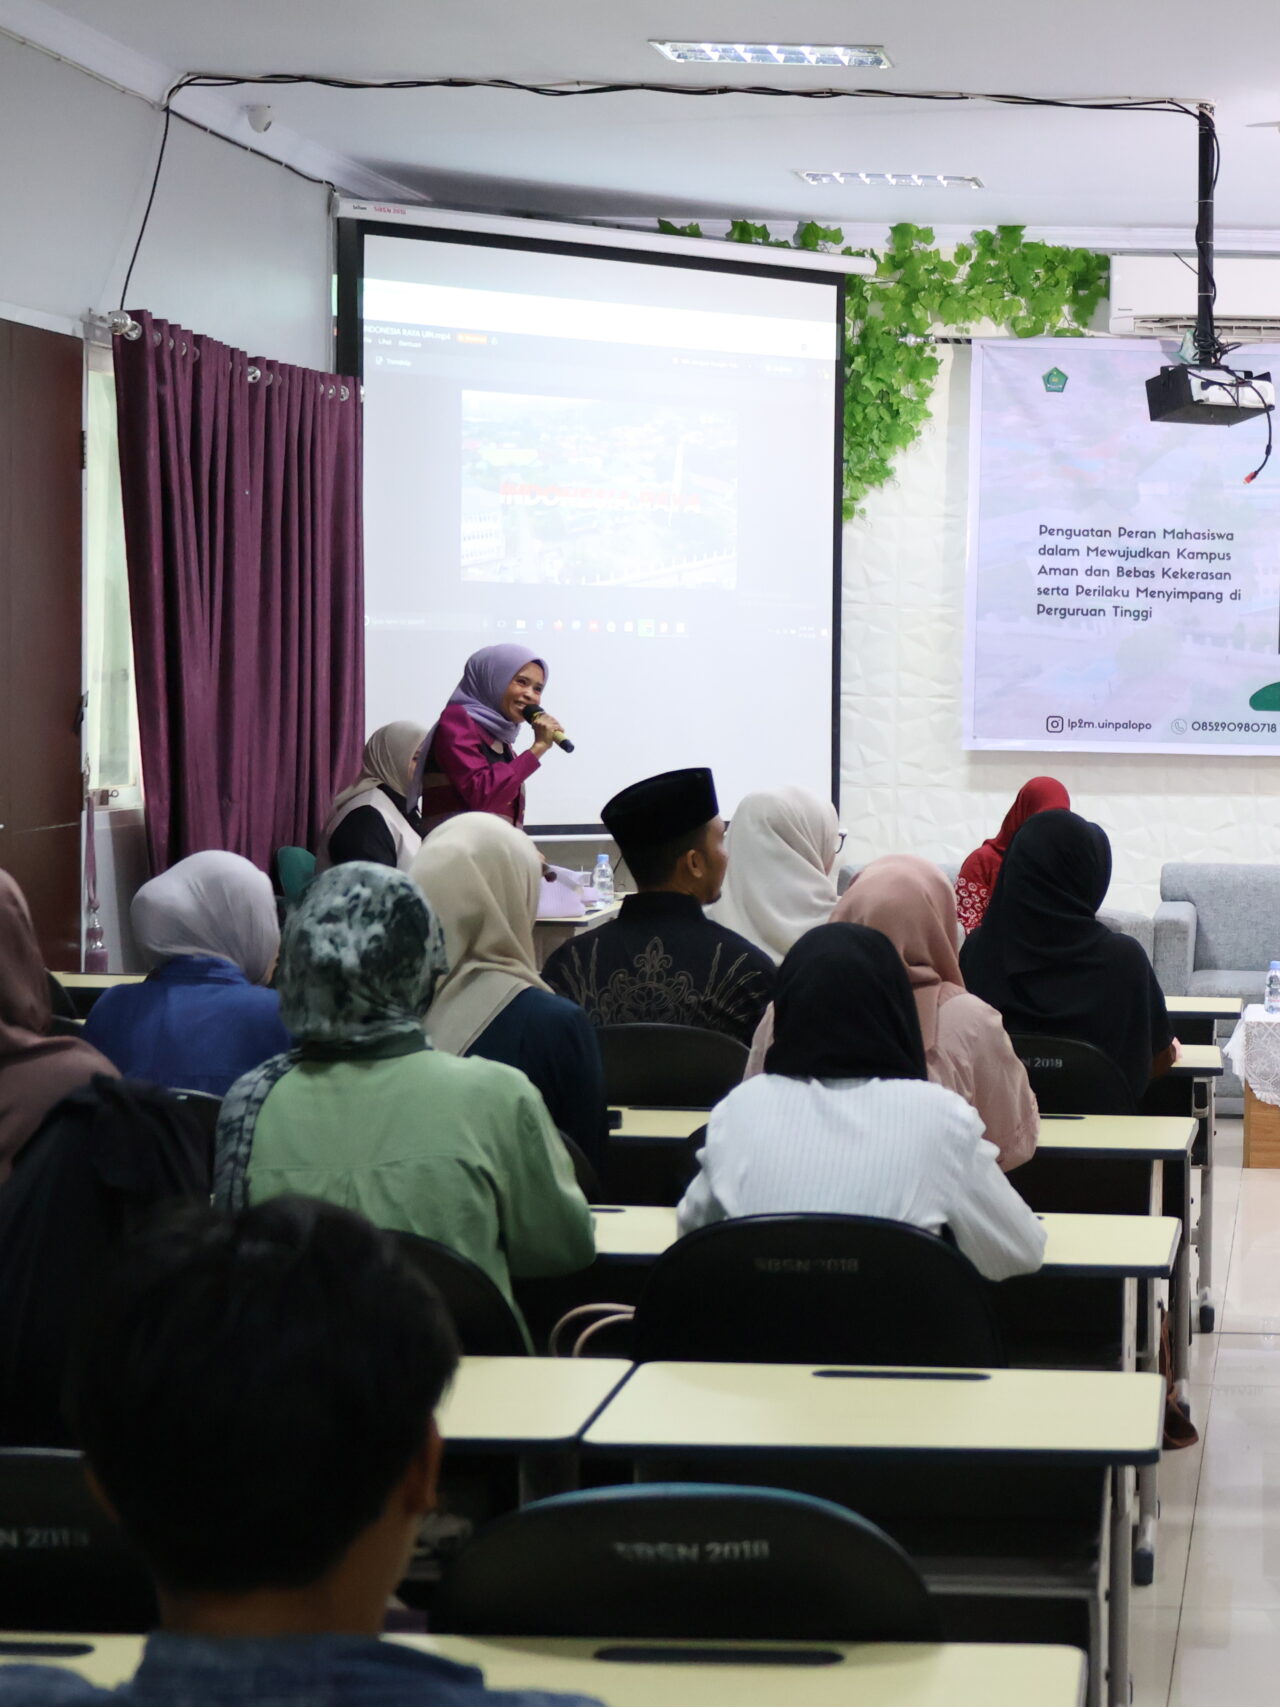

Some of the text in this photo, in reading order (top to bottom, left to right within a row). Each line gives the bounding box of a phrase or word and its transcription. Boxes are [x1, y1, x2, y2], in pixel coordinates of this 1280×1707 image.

[1039, 524, 1234, 541] Penguatan Peran Mahasiswa
[1038, 544, 1232, 563] dalam Mewujudkan Kampus
[1037, 564, 1232, 581] Aman dan Bebas Kekerasan
[1036, 584, 1241, 603] serta Perilaku Menyimpang di
[1036, 603, 1153, 621] Perguruan Tinggi
[1067, 718, 1152, 732] lp2m.uinpalopo
[1191, 721, 1277, 734] 085290980718
